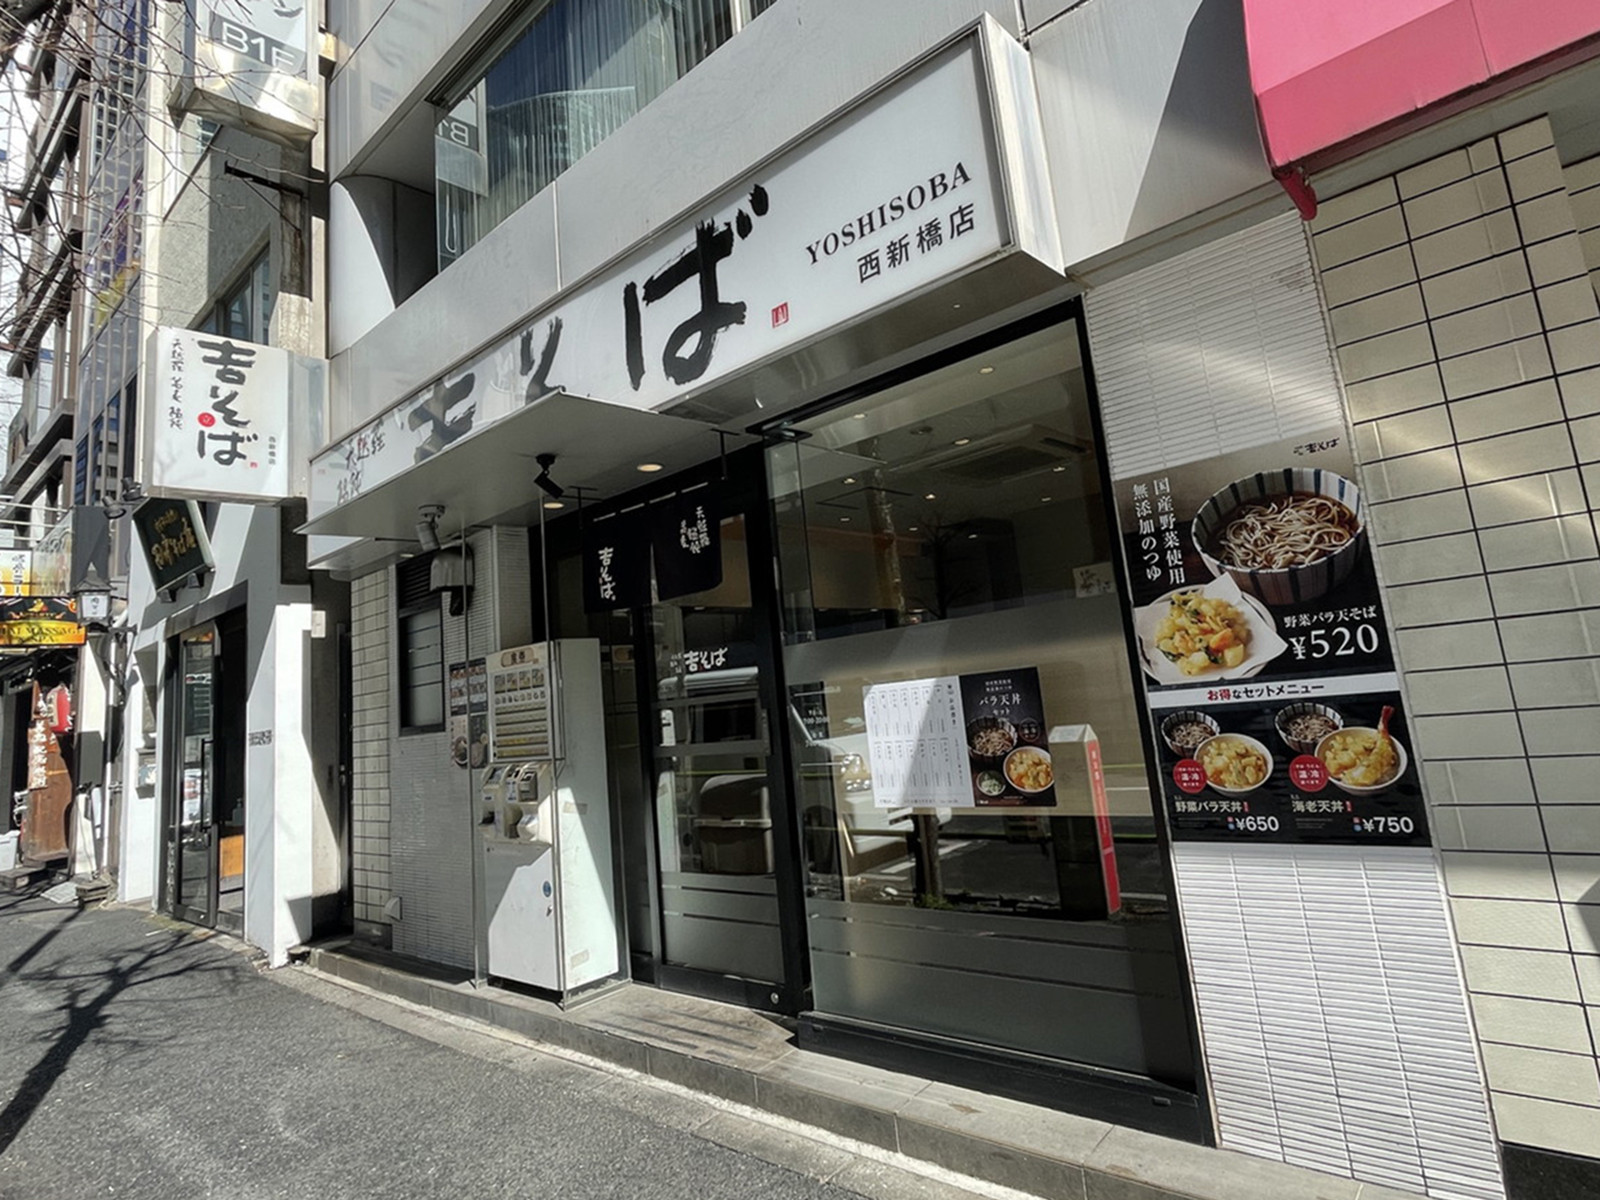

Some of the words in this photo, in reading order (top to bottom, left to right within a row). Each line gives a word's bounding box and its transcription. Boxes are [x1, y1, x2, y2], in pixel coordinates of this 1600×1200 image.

[222, 21, 296, 67] B1F
[806, 162, 971, 265] YOSHISOBA
[857, 203, 975, 284] 西新橋店
[197, 340, 259, 467] 吉そば
[1132, 483, 1163, 582] 無添加のつゆ
[1153, 477, 1185, 585] 国産野菜使用
[598, 547, 616, 599] 吉そば
[1283, 605, 1377, 628] 野菜バラ天そば
[1289, 624, 1379, 660] ¥520
[683, 647, 728, 672] 吉そば
[979, 693, 1021, 706] バラ天丼
[1207, 684, 1325, 701] お得なセットメニュー
[1175, 801, 1243, 813] 野菜バラ天丼
[1292, 800, 1344, 813] 海老天丼
[1235, 816, 1280, 832] ¥650
[1362, 816, 1414, 833] ¥750
